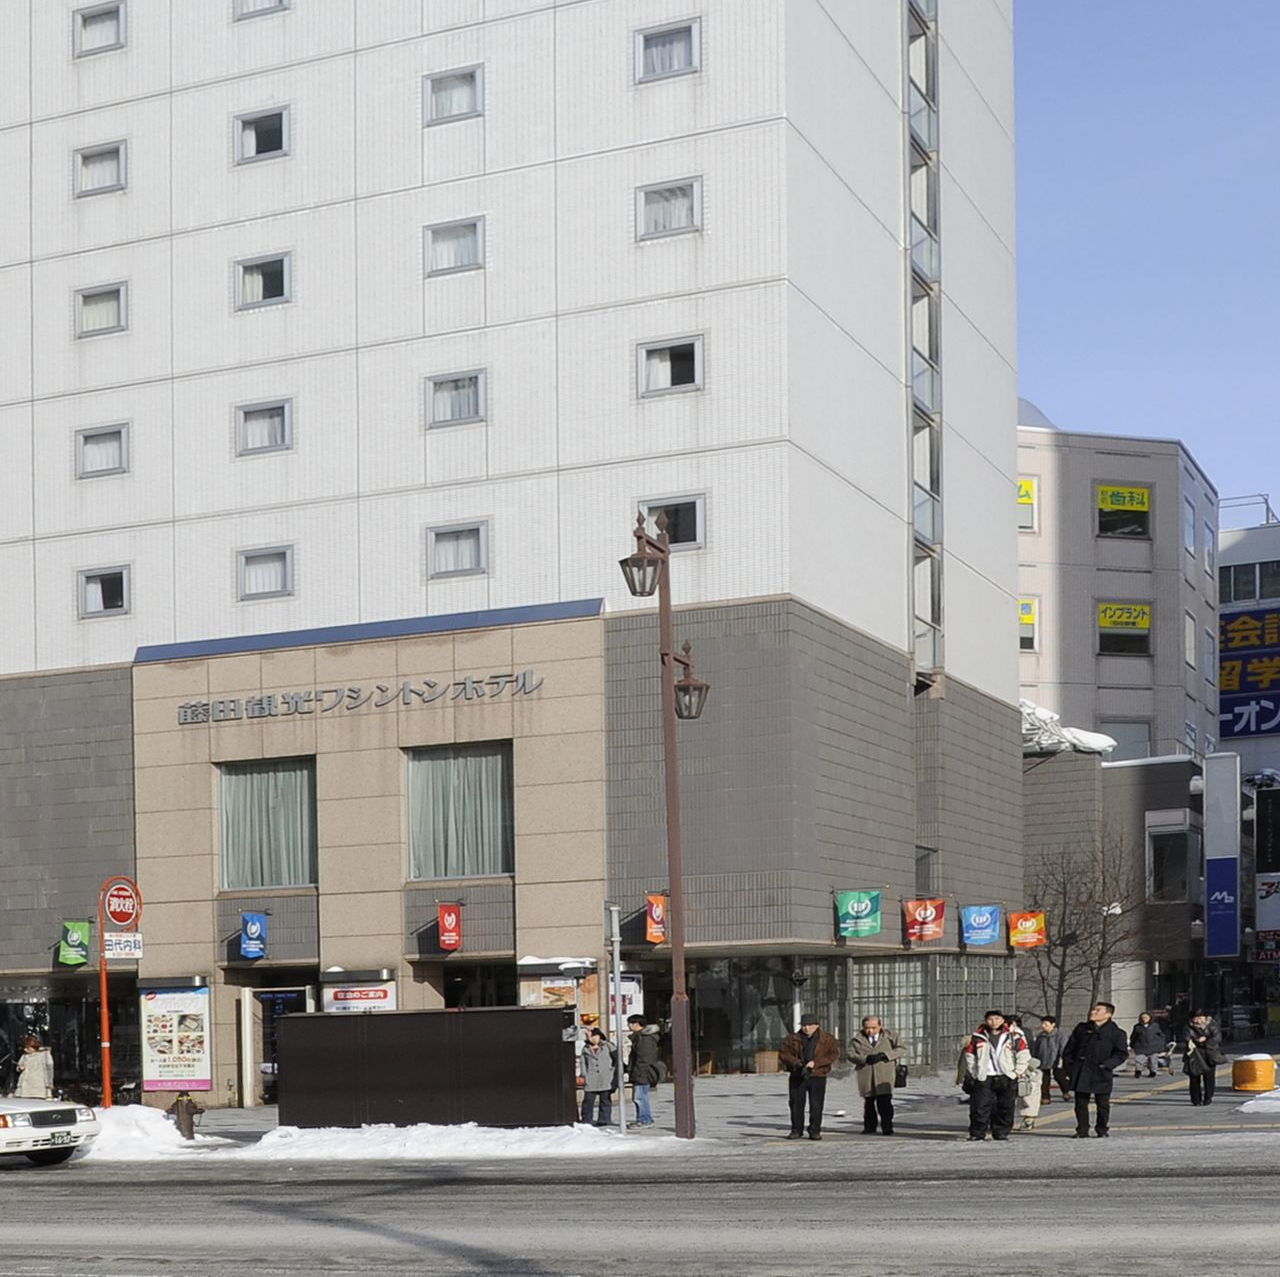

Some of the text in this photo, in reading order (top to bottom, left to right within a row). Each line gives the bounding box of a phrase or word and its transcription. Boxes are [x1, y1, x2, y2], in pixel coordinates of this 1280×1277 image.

[1110, 490, 1146, 506] 歯科
[1101, 606, 1148, 620] インプラント
[177, 669, 544, 725] 藤田観光ワシントンホテル
